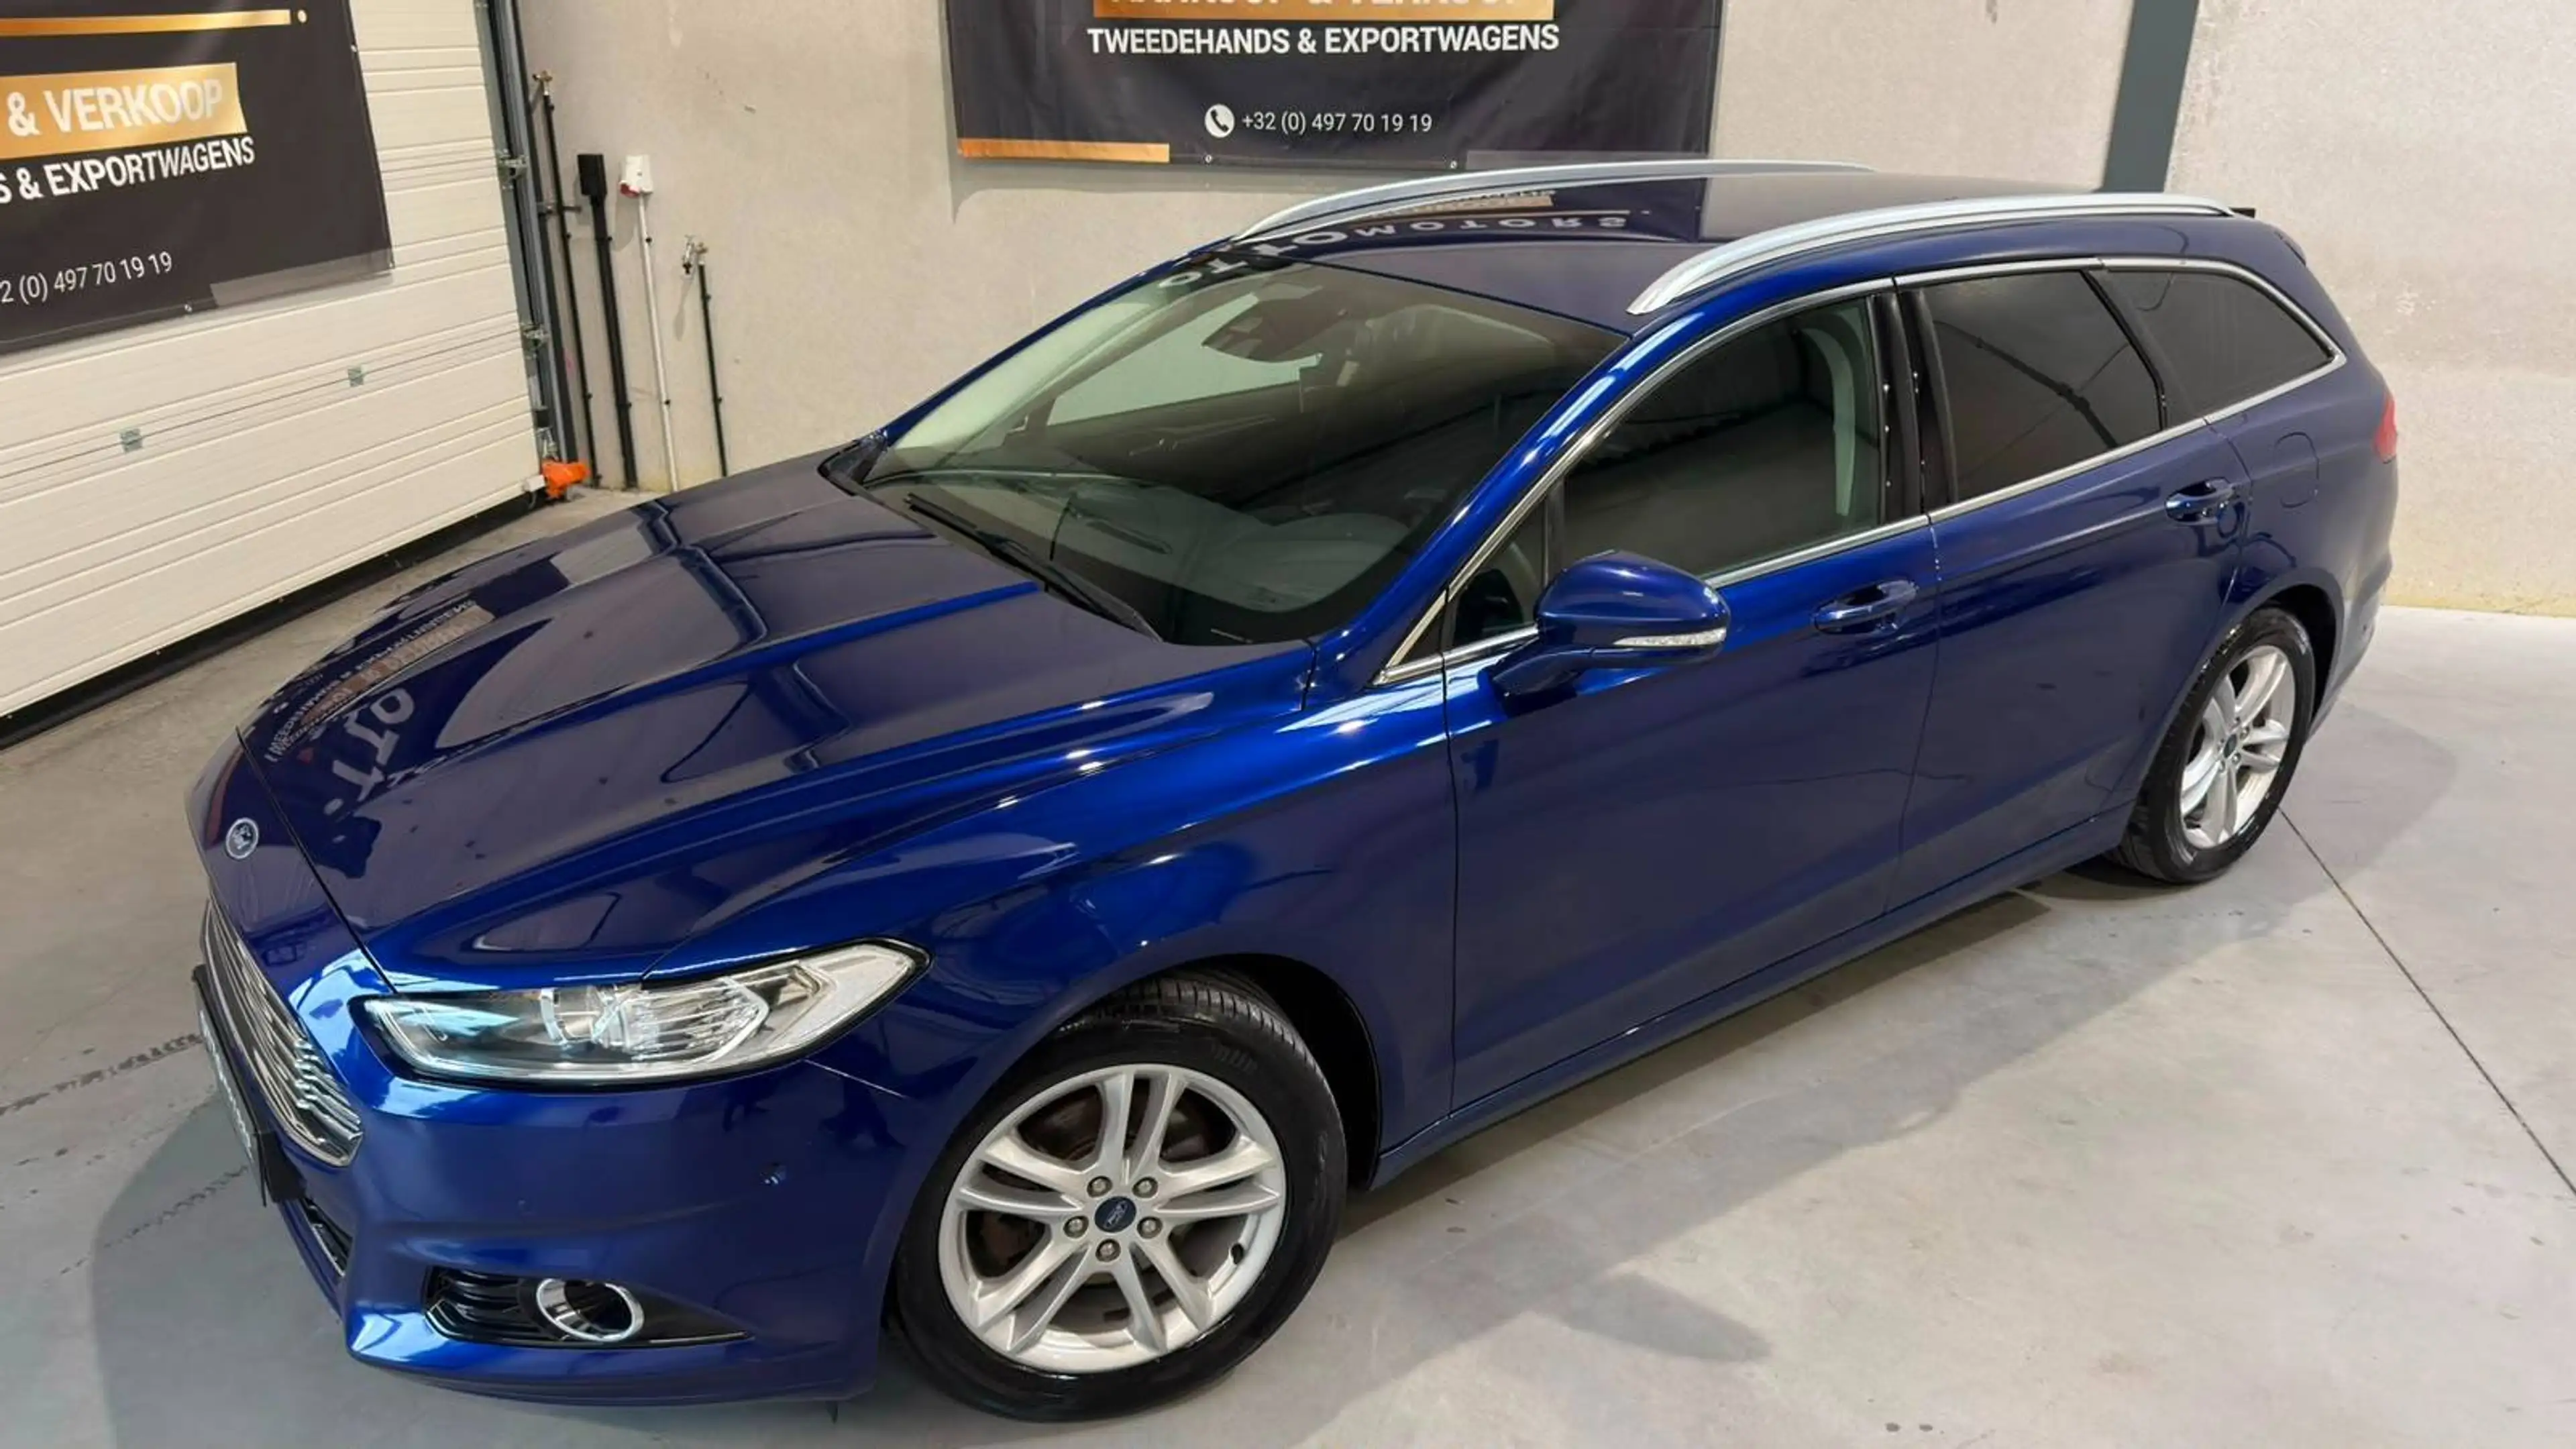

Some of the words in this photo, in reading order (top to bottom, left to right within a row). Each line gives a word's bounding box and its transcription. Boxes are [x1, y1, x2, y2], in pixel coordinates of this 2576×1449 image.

[1087, 28, 1291, 54] TWEEDEHANDS
[1297, 27, 1317, 54] &
[1325, 24, 1560, 54] EXPORTWAGENS
[7, 91, 40, 136] &
[43, 78, 223, 133] VERKOOP
[1242, 111, 1276, 131] +32
[1281, 111, 1306, 135] (0)
[1311, 113, 1347, 131] 497
[1352, 113, 1375, 132] 70
[1381, 114, 1404, 132] 19
[1410, 114, 1434, 133] 19
[16, 167, 44, 200] &
[44, 136, 256, 197] EXPORTWAGENS
[19, 272, 48, 305] (0)
[54, 266, 88, 293] 497
[91, 261, 117, 286] 70
[119, 256, 145, 280] 19
[148, 250, 172, 275] 19
